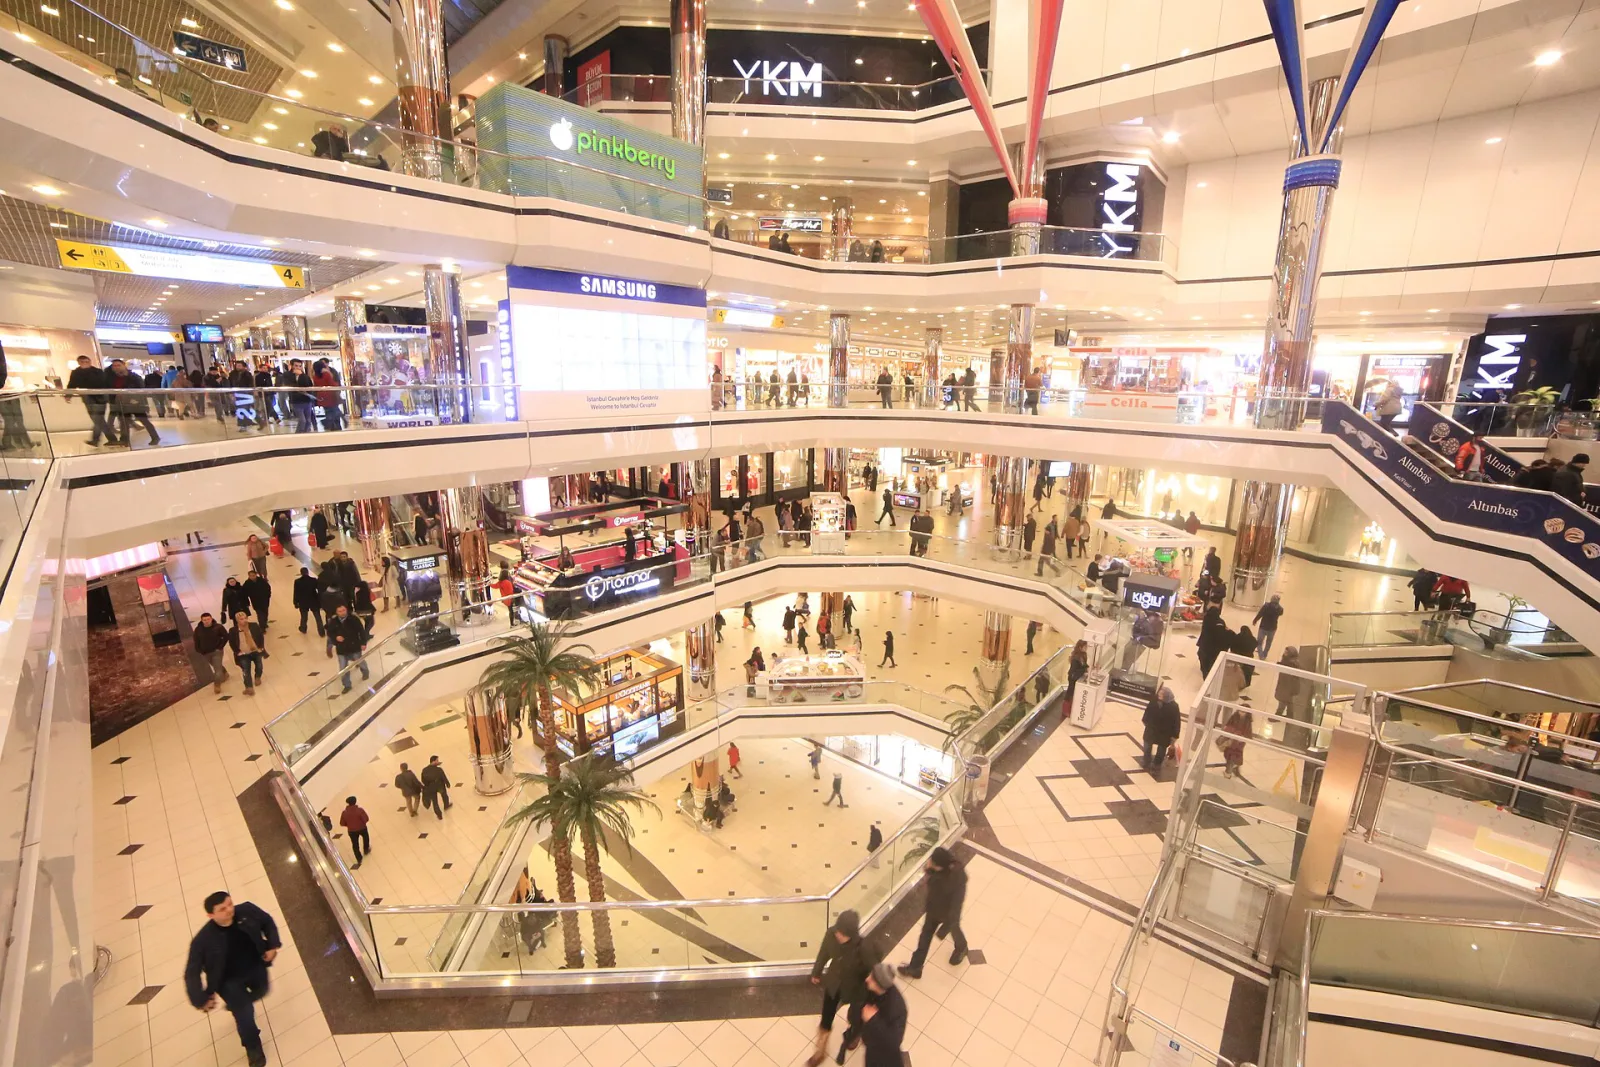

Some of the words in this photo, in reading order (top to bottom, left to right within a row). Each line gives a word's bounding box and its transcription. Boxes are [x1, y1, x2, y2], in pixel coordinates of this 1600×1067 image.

[733, 59, 822, 97] YKM
[577, 129, 676, 180] pinkberry
[1102, 163, 1140, 258] YKM
[283, 269, 292, 280] 4
[580, 276, 657, 299] SAMSUNG
[1111, 397, 1148, 408] Cella
[1398, 456, 1432, 484] Altınbaş
[1484, 453, 1516, 478] Altınba
[1467, 499, 1519, 518] Altınbaş
